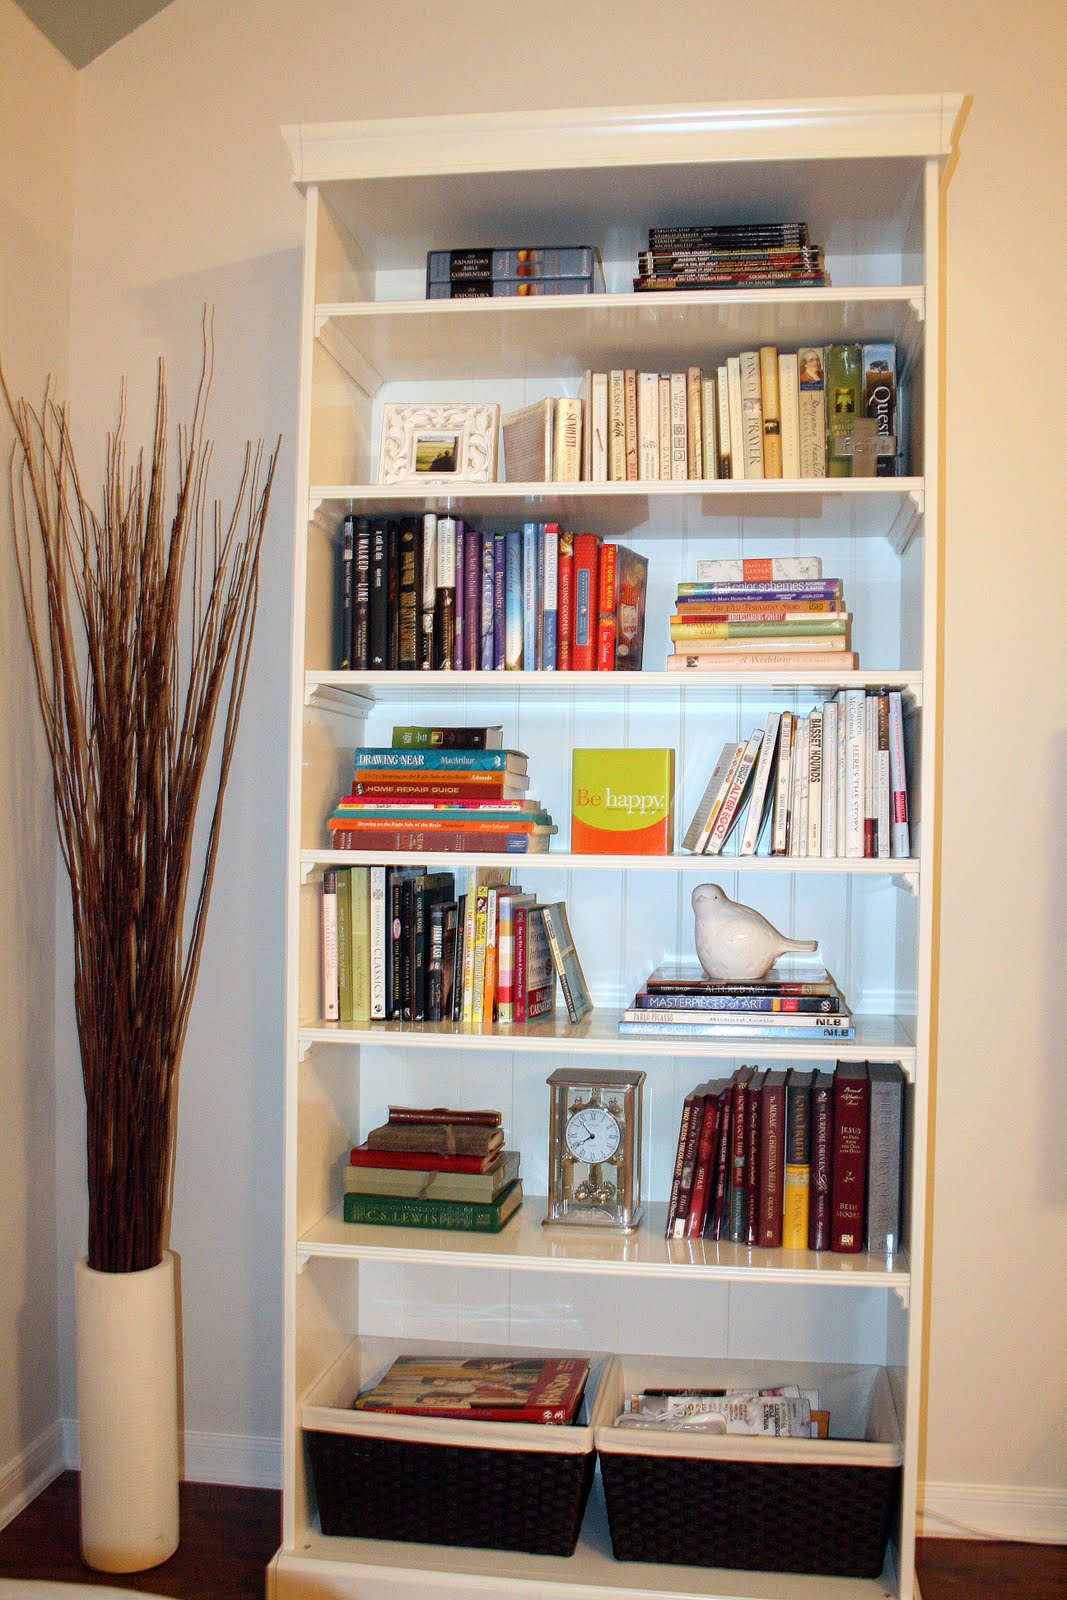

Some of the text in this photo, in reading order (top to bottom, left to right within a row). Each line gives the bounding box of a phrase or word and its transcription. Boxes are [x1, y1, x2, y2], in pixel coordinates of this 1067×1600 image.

[747, 355, 757, 392] YANCEY
[614, 387, 622, 405] CASE
[614, 405, 622, 417] FOR
[869, 386, 890, 436] Quest
[564, 413, 577, 449] SCARLETT
[613, 418, 624, 438] faith
[748, 417, 760, 465] PRAYER
[808, 395, 824, 478] Benjamin Franklin
[358, 538, 368, 602] WALKED LINE
[548, 534, 557, 608] MISTAKEN IDENTITY
[494, 571, 503, 609] Personality
[734, 581, 804, 591] color schemes
[782, 602, 801, 610] STORY
[808, 602, 823, 610] USED
[749, 656, 791, 666] Wedding
[848, 696, 856, 741] McCormick
[856, 701, 864, 735] Maureen
[359, 754, 424, 766] DRAWING NEAR
[763, 734, 774, 757] DIVINE
[810, 718, 822, 783] BASSET HOUNDS
[577, 788, 602, 807] Be
[714, 782, 741, 840] ALTER EGO?
[358, 820, 377, 828] Drawing
[433, 925, 442, 958] JOHNNY CASH
[373, 948, 382, 999] CLASSICS
[749, 984, 766, 993] ART
[560, 976, 573, 1011] MACHIAVELLI
[649, 997, 763, 1009] MASTERPIECES ART
[633, 1013, 674, 1022] PABLO PICASSO
[816, 1018, 842, 1026] NLB
[686, 1106, 699, 1158] Passion Purity
[736, 1113, 743, 1124] WE
[794, 1094, 805, 1161] TOTAL TRUTH
[841, 1126, 861, 1134] JESUS
[675, 1107, 690, 1177] WHO NEEDS THEOLOGY?
[768, 1103, 777, 1194] MOSAIC CHRISTIAN BELIEF
[879, 1133, 890, 1176] STORY
[818, 1144, 826, 1171] DRIVEN
[696, 1167, 705, 1190] ARTHUR
[670, 1179, 680, 1216] Grenz Olson
[679, 1194, 687, 1212] Elliot
[367, 1209, 438, 1224] C.S. LEWIS
